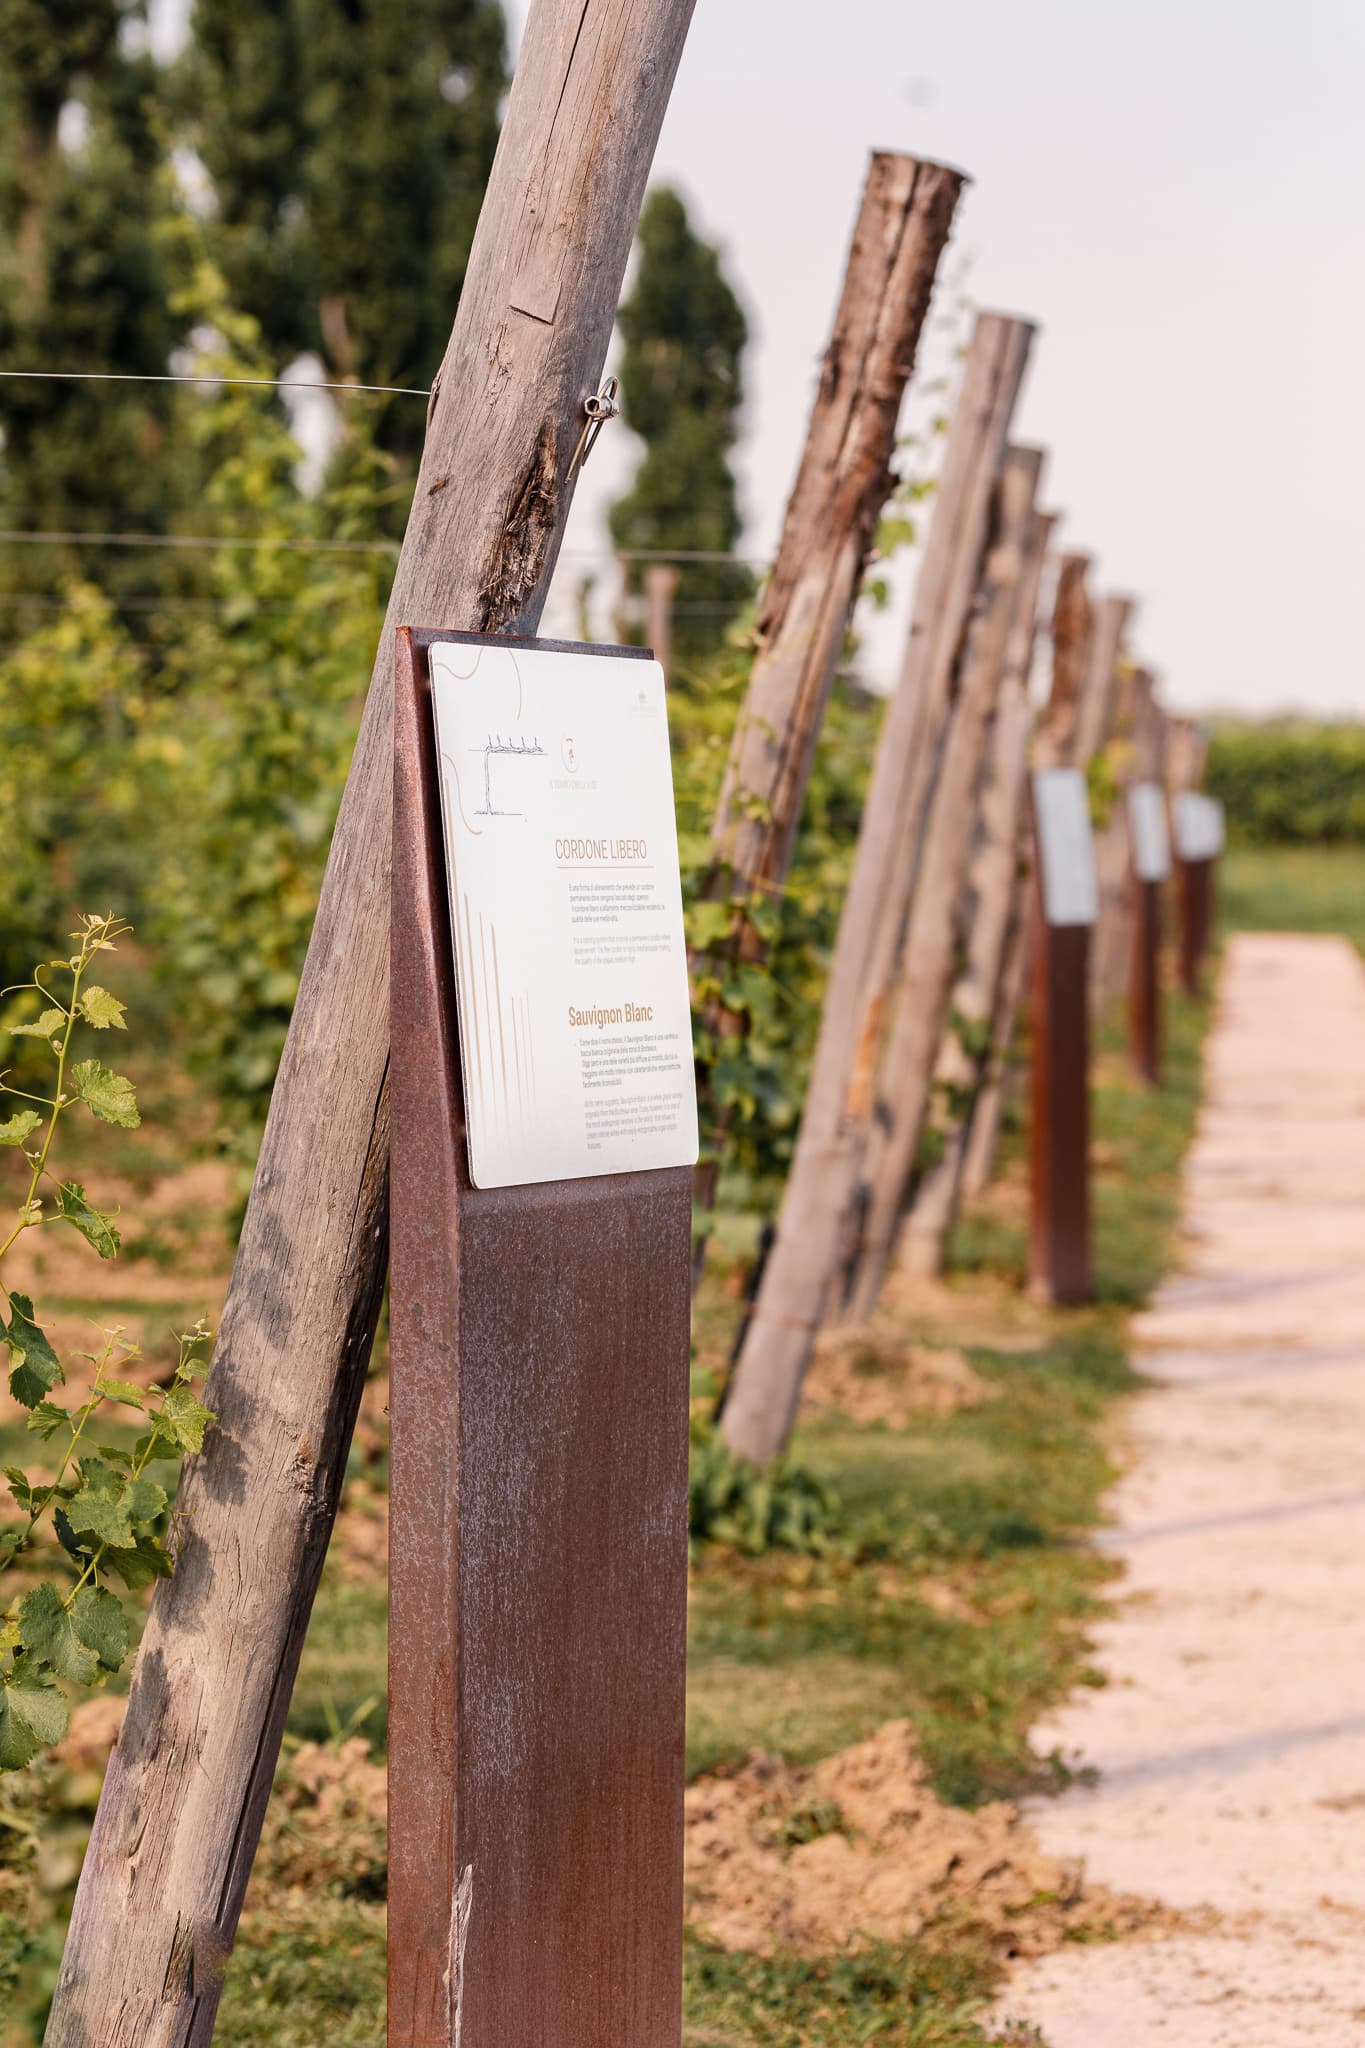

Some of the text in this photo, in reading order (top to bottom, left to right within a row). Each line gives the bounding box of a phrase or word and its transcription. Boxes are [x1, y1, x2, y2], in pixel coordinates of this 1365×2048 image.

[555, 839, 647, 859] CORDONE LIBERO
[568, 1002, 653, 1029] Sauvignon Blanc
